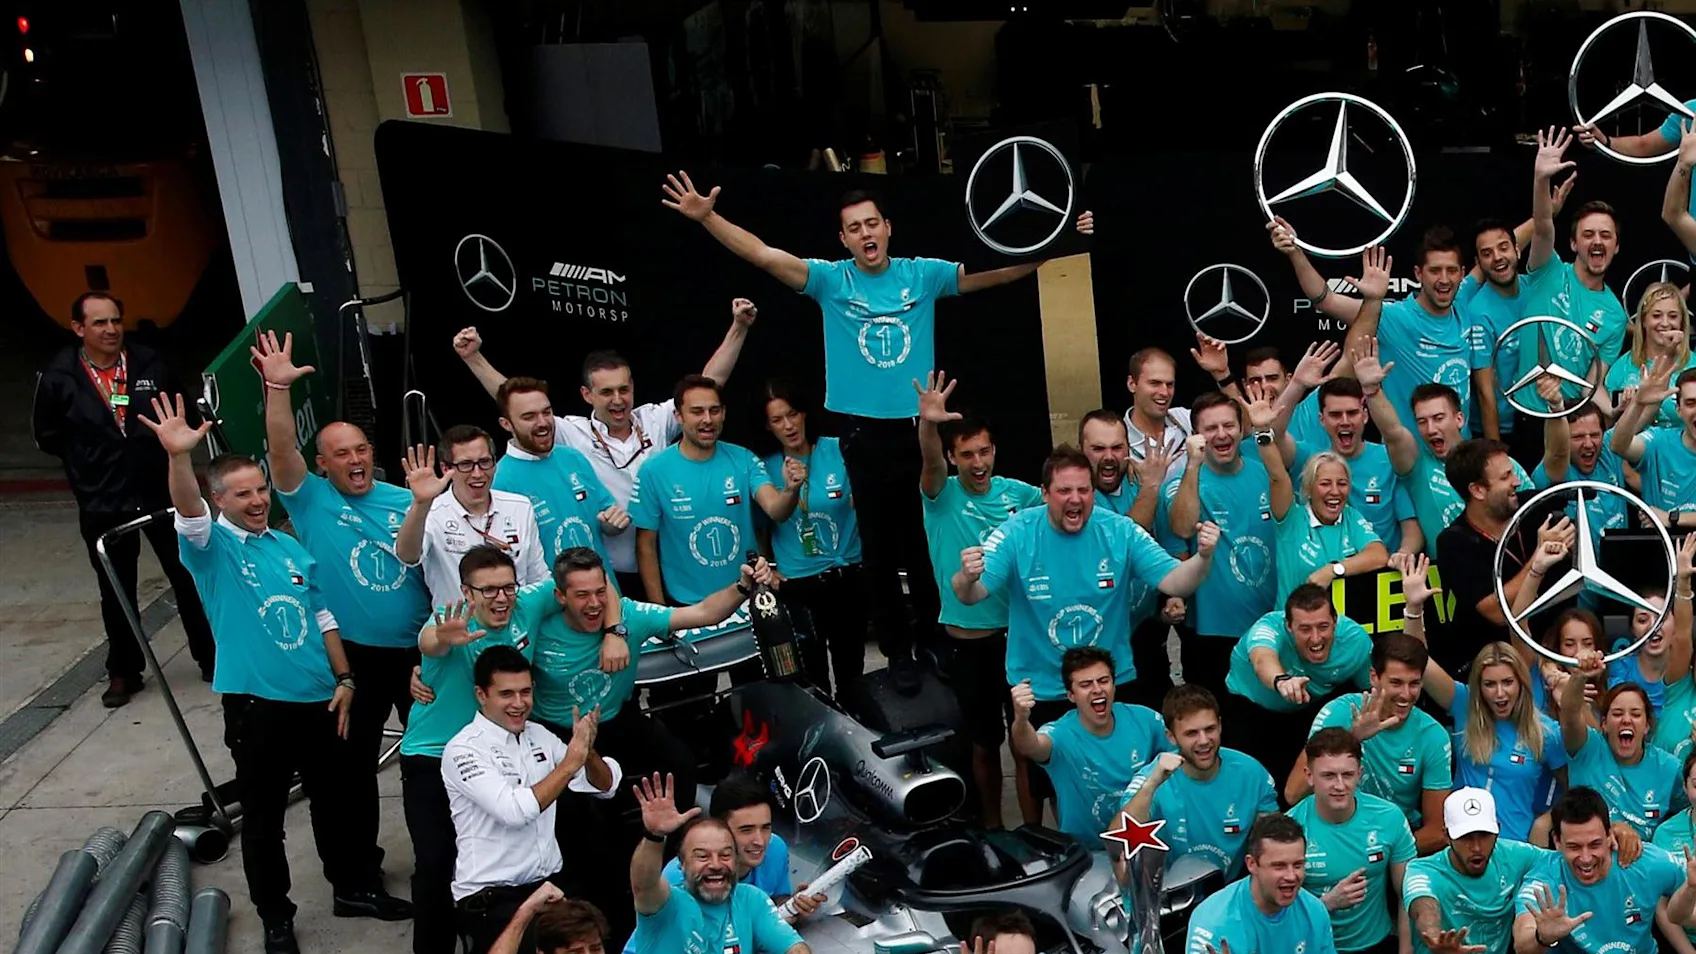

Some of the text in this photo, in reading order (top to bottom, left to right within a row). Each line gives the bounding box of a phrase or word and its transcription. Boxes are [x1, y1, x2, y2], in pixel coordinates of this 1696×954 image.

[552, 300, 629, 322] MOTORSP
[876, 325, 892, 357] 1
[706, 527, 722, 557] 1
